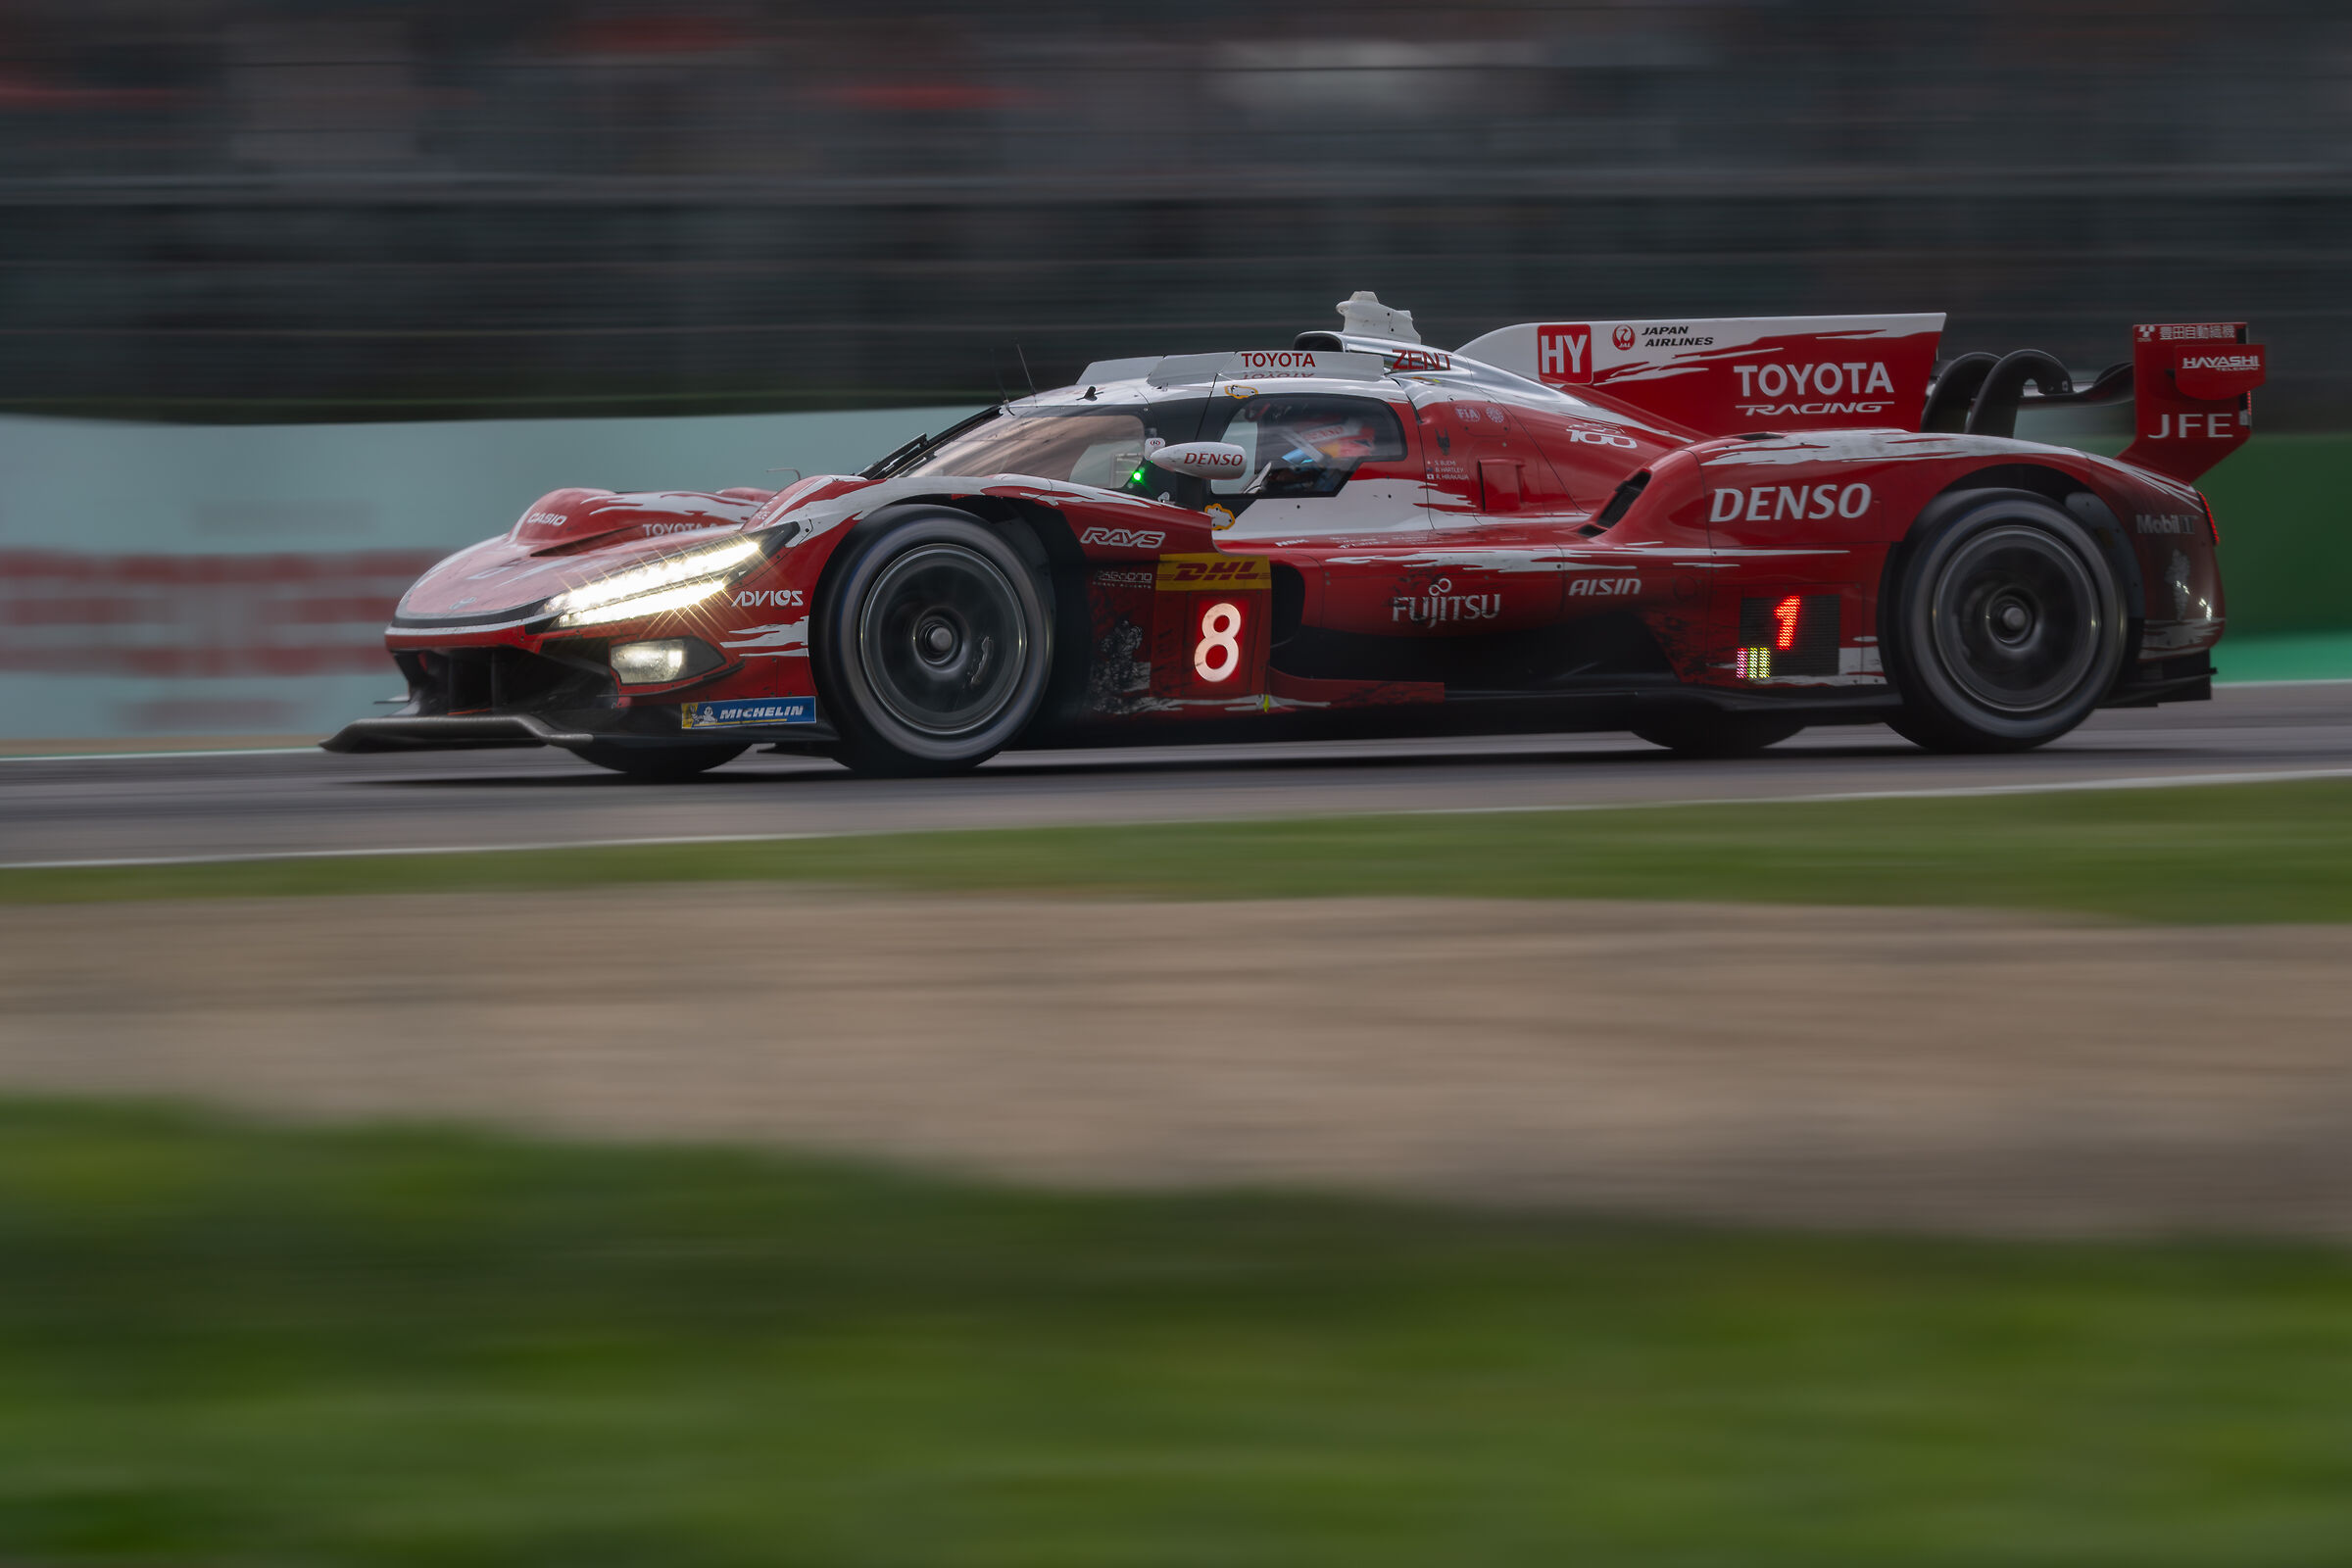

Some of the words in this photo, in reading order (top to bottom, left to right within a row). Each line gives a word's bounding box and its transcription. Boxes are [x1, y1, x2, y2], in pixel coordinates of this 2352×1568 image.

[1642, 326, 1689, 335] JAPAN
[1644, 337, 1714, 347] AIRLINES
[1241, 353, 1316, 368] TOYOTA
[1392, 349, 1452, 370] ZENT
[1540, 334, 1588, 374] HY
[2181, 355, 2260, 369] HAYASHI
[1734, 362, 1894, 397] TOYOTA
[1736, 402, 1894, 416] RACING
[2147, 414, 2233, 438] JFE
[1566, 428, 1638, 449] 100
[1183, 453, 1244, 466] DENSO
[1710, 483, 1872, 522] DENSO
[527, 512, 567, 526] CASIO
[2135, 514, 2180, 534] Mobil
[1080, 527, 1165, 548] RAYS
[1176, 562, 1258, 581] DHL
[1569, 578, 1642, 596] AISIN
[1392, 594, 1501, 627] FUJITSU
[1772, 595, 1801, 651] 1
[1194, 603, 1242, 683] 8
[719, 706, 805, 719] MICHELIN
